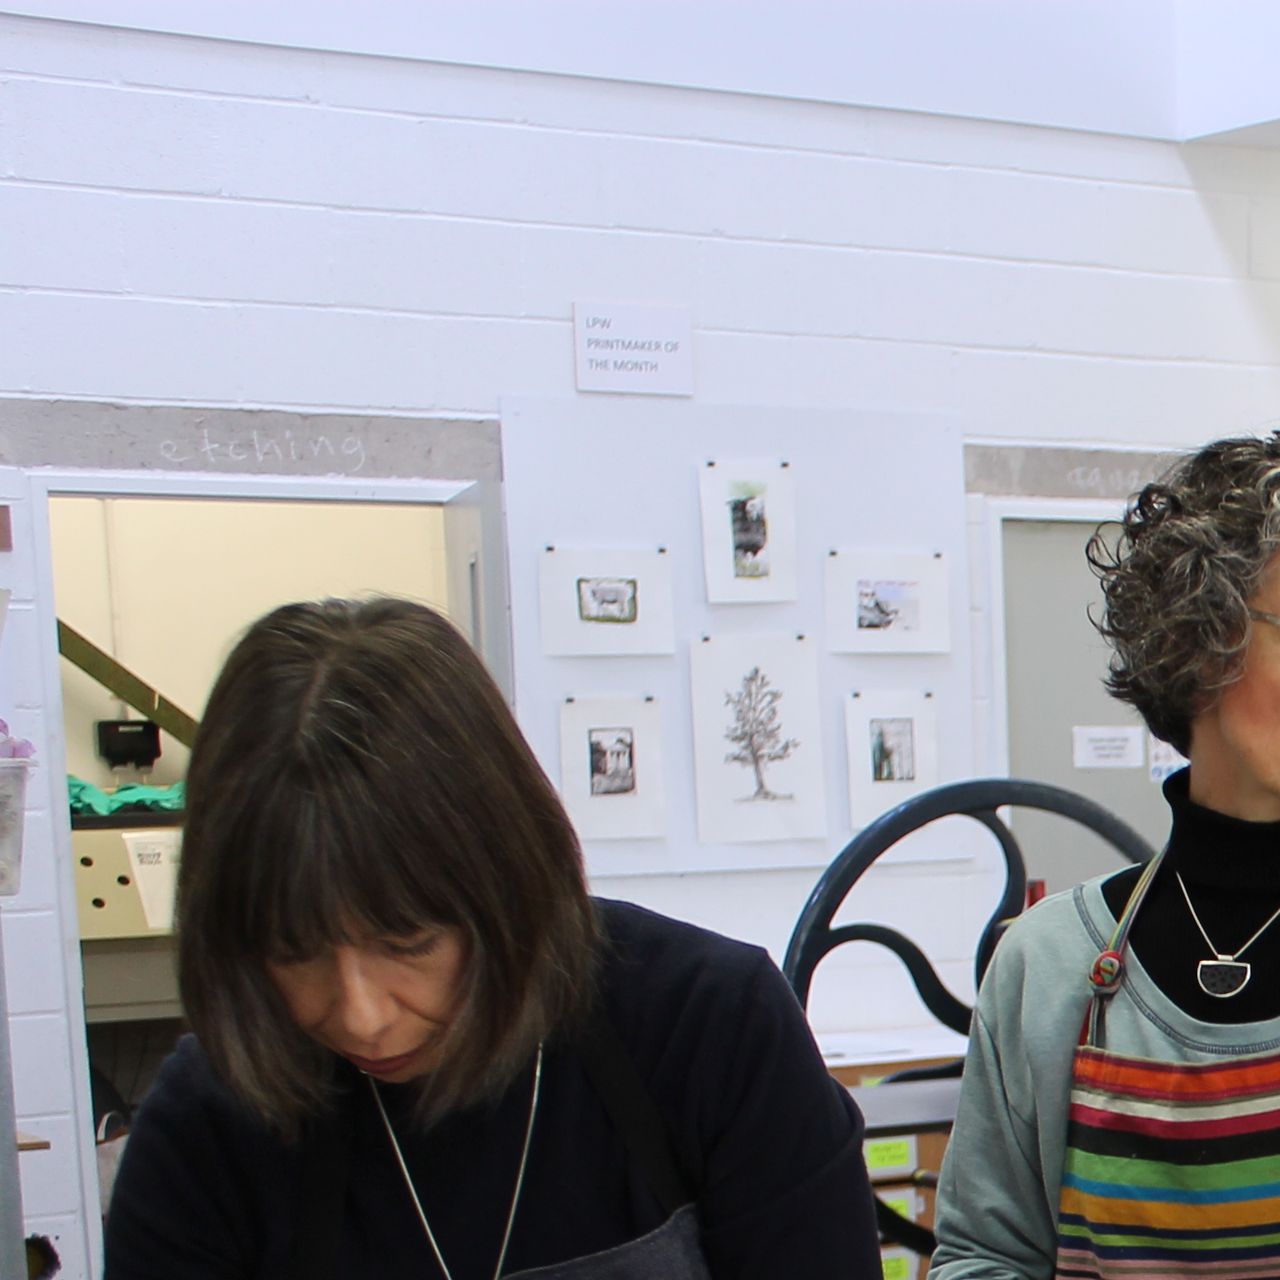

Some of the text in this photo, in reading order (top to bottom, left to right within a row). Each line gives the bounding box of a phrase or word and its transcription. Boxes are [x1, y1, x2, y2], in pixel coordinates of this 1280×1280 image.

[586, 316, 612, 329] LPW
[587, 338, 680, 353] PRINTMAKER OF
[588, 359, 659, 372] THE MONTH
[160, 428, 366, 473] etching
